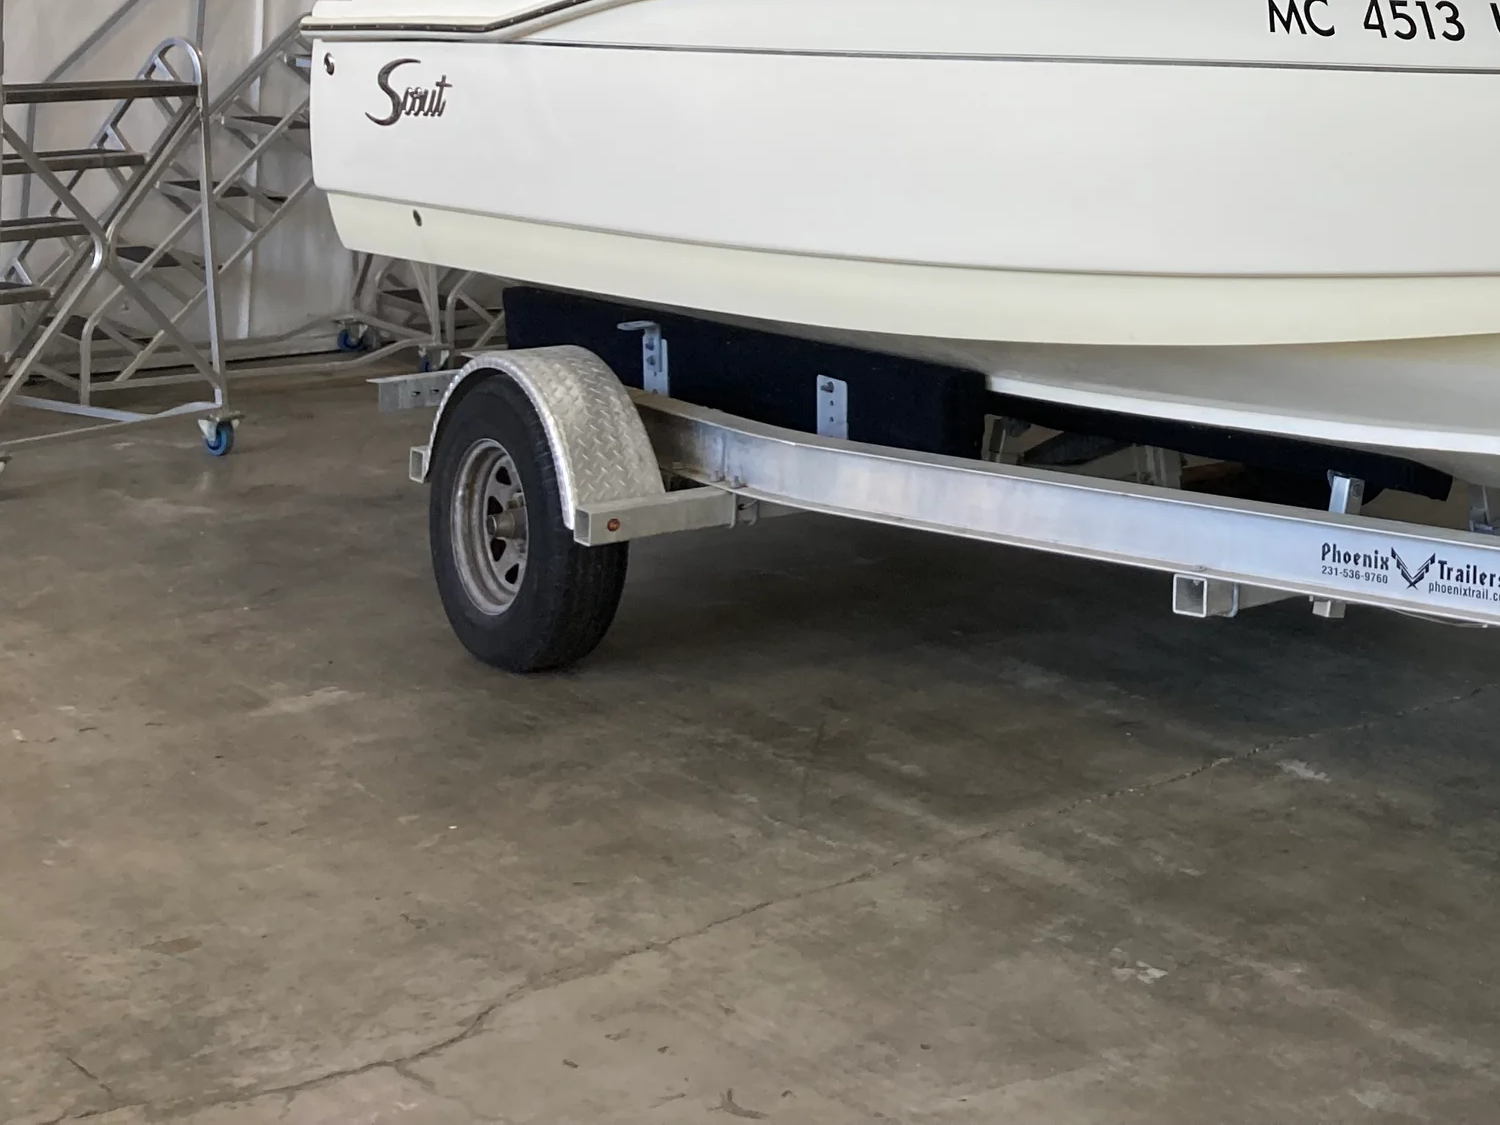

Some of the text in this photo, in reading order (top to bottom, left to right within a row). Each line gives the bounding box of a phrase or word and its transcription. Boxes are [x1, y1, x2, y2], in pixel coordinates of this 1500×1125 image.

[364, 58, 453, 126] Scout
[1321, 542, 1390, 571] Phoenix
[1321, 565, 1389, 584] 231-536-9760
